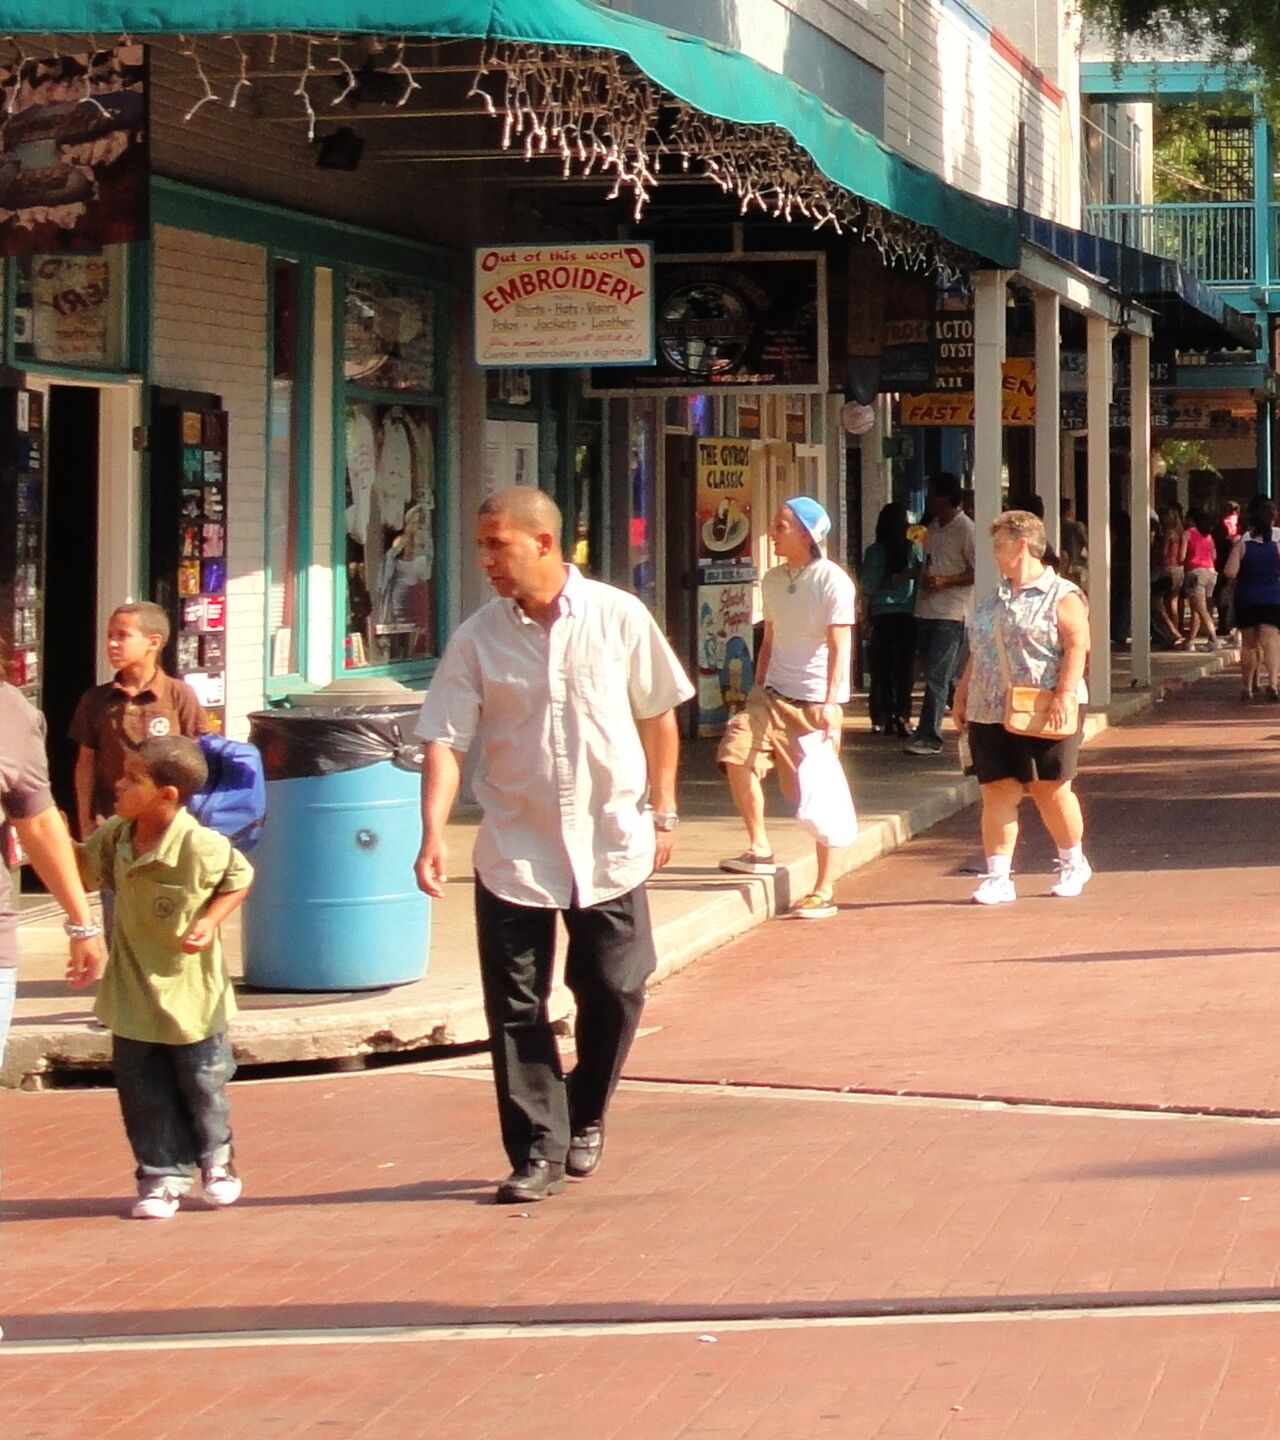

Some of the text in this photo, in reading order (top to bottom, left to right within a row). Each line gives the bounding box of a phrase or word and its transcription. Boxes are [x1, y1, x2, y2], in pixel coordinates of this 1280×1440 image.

[481, 251, 516, 272] Out
[523, 251, 542, 262] of
[550, 250, 577, 261] this
[482, 266, 645, 314] EMBROIDERY
[591, 317, 635, 330] Leather
[935, 320, 975, 339] ACTO
[940, 342, 975, 358] OYST
[908, 406, 960, 421] FAST
[700, 443, 749, 467] THE GYROS
[705, 470, 744, 490] CLASSIC
